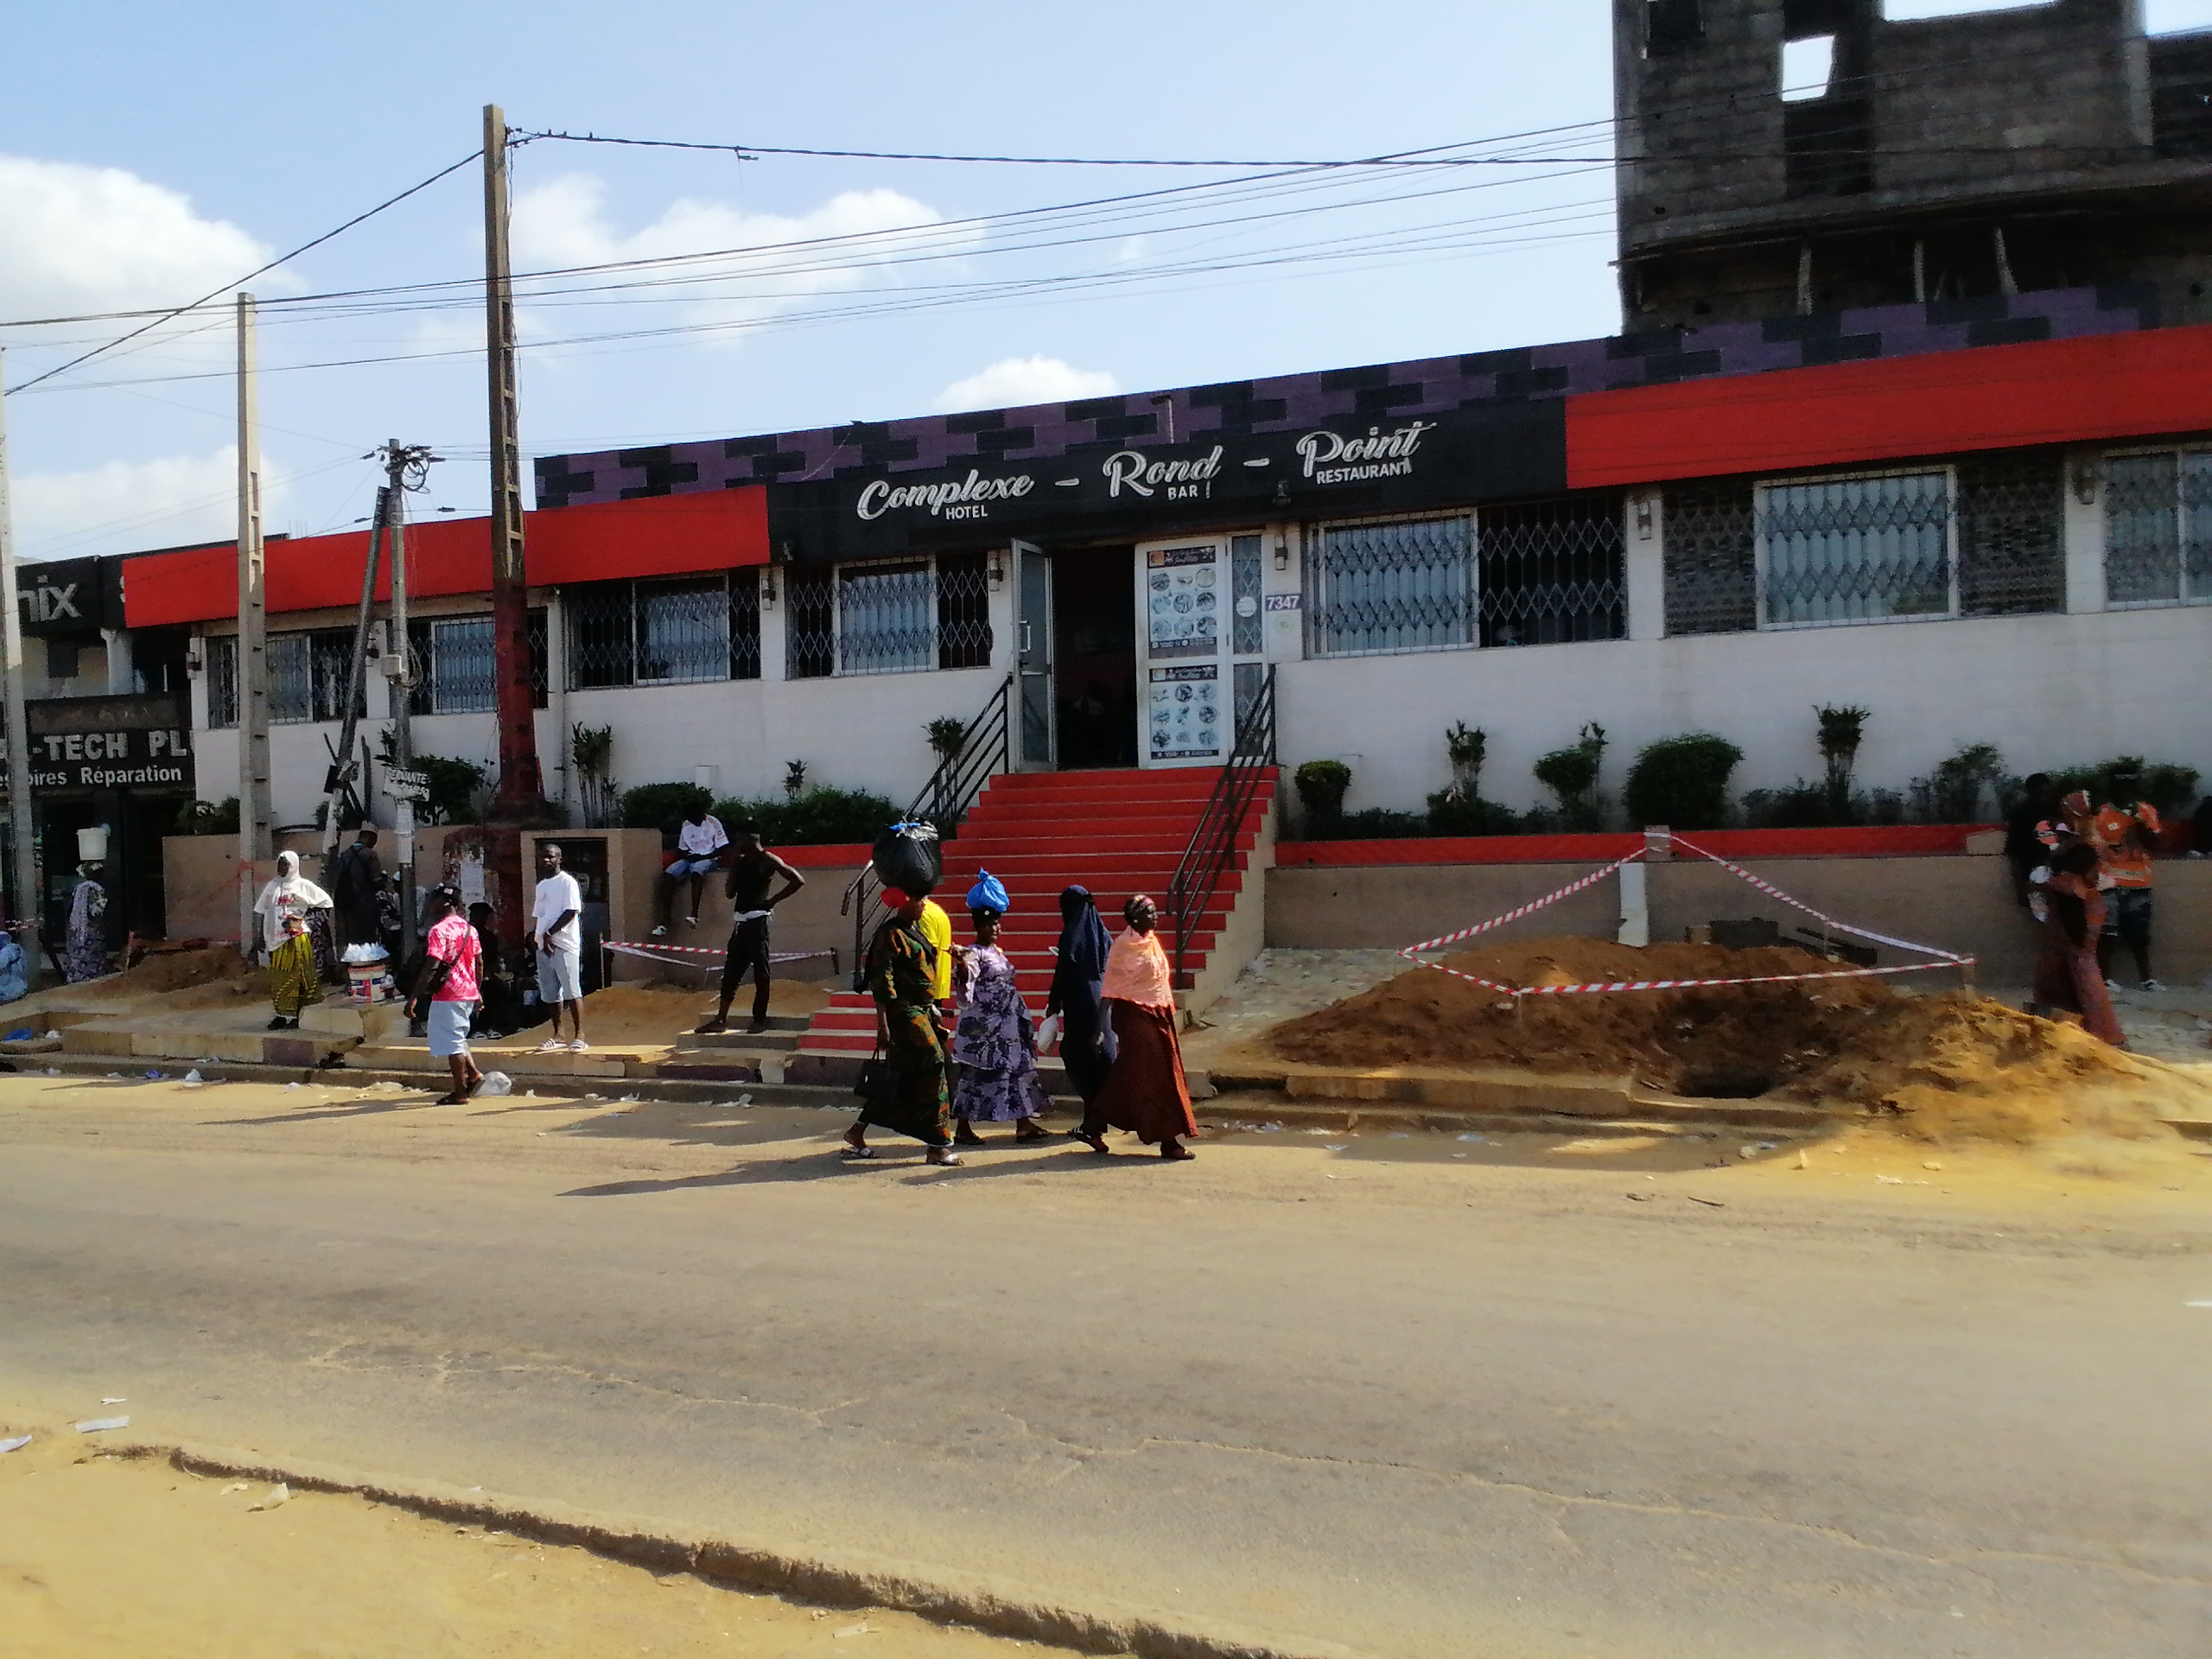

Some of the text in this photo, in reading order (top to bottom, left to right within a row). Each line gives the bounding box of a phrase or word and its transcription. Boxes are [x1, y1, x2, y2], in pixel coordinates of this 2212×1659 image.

[857, 468, 1035, 520] Complexe
[1103, 444, 1224, 498] Rond
[1296, 420, 1438, 478] Point
[1316, 458, 1413, 485] RESTAURANT
[1167, 484, 1199, 501] BAR
[945, 505, 988, 520] HOTEL
[1266, 594, 1300, 610] 7347
[149, 729, 194, 758] PL
[80, 765, 182, 788] Réparation
